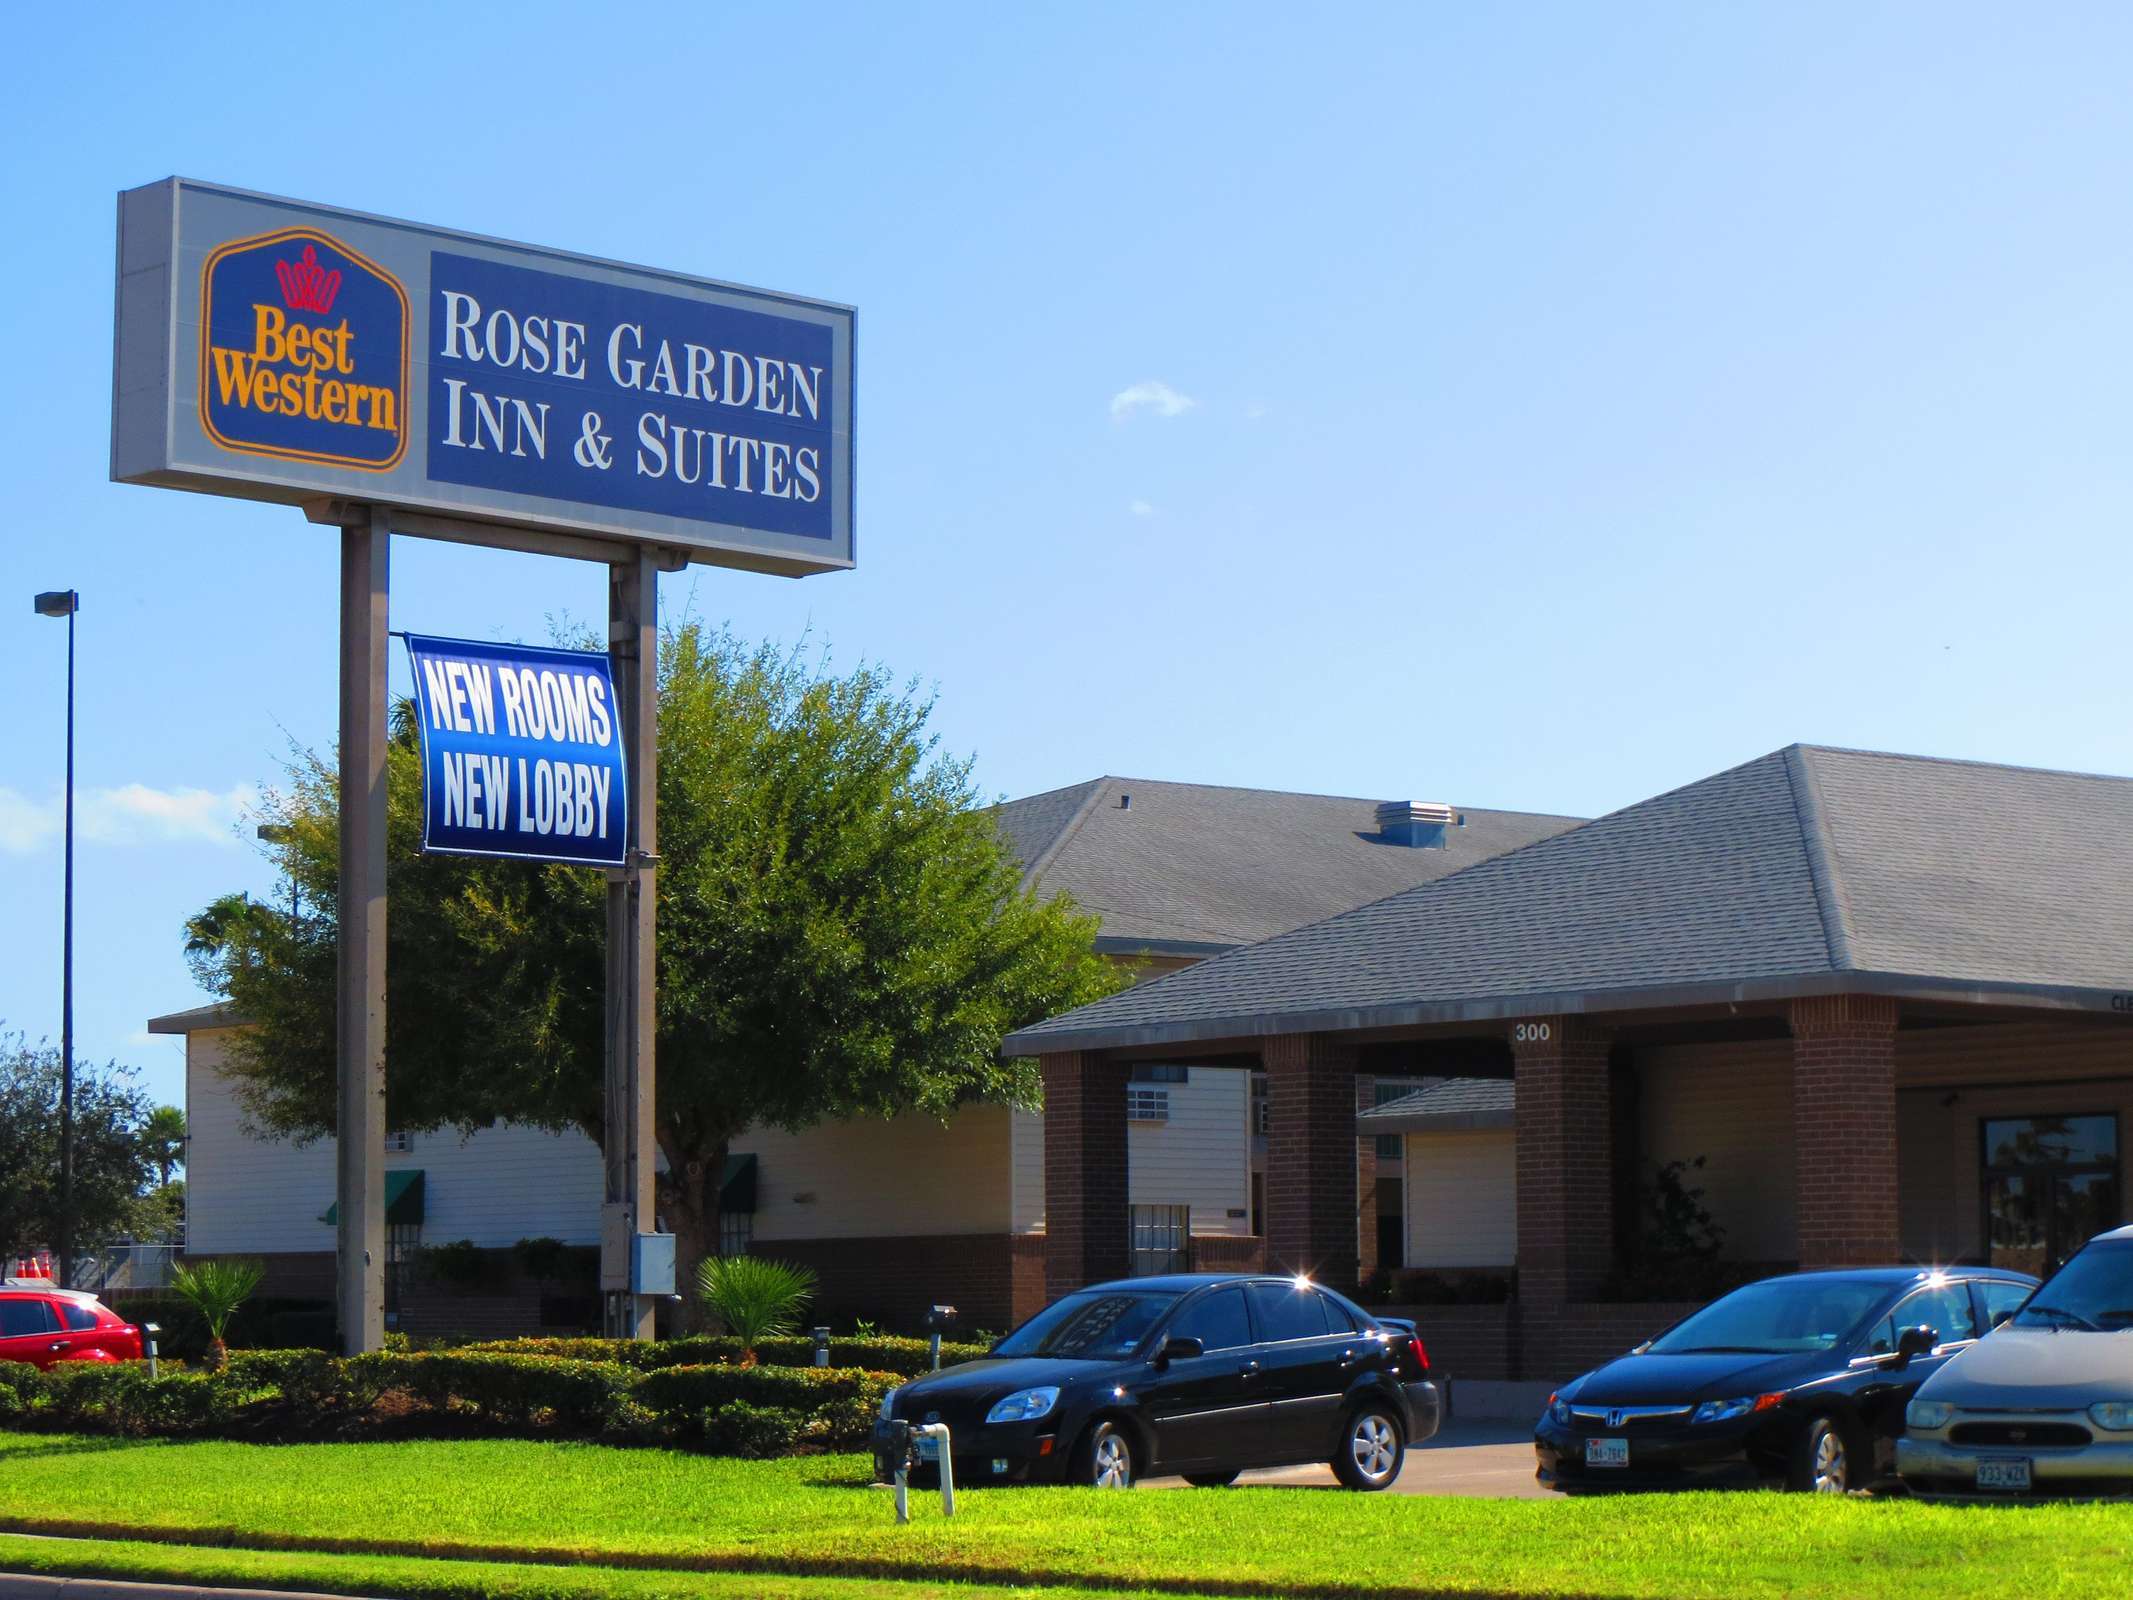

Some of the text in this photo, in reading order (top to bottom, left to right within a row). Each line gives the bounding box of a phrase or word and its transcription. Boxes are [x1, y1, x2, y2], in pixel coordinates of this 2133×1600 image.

[253, 304, 354, 374] Best
[441, 290, 823, 420] ROSE GARDEN
[211, 347, 398, 431] Western
[442, 378, 820, 502] INN & SUITES
[423, 659, 611, 747] NEW ROOMS
[443, 751, 611, 839] NEW LOBBY
[1516, 1023, 1550, 1041] 300
